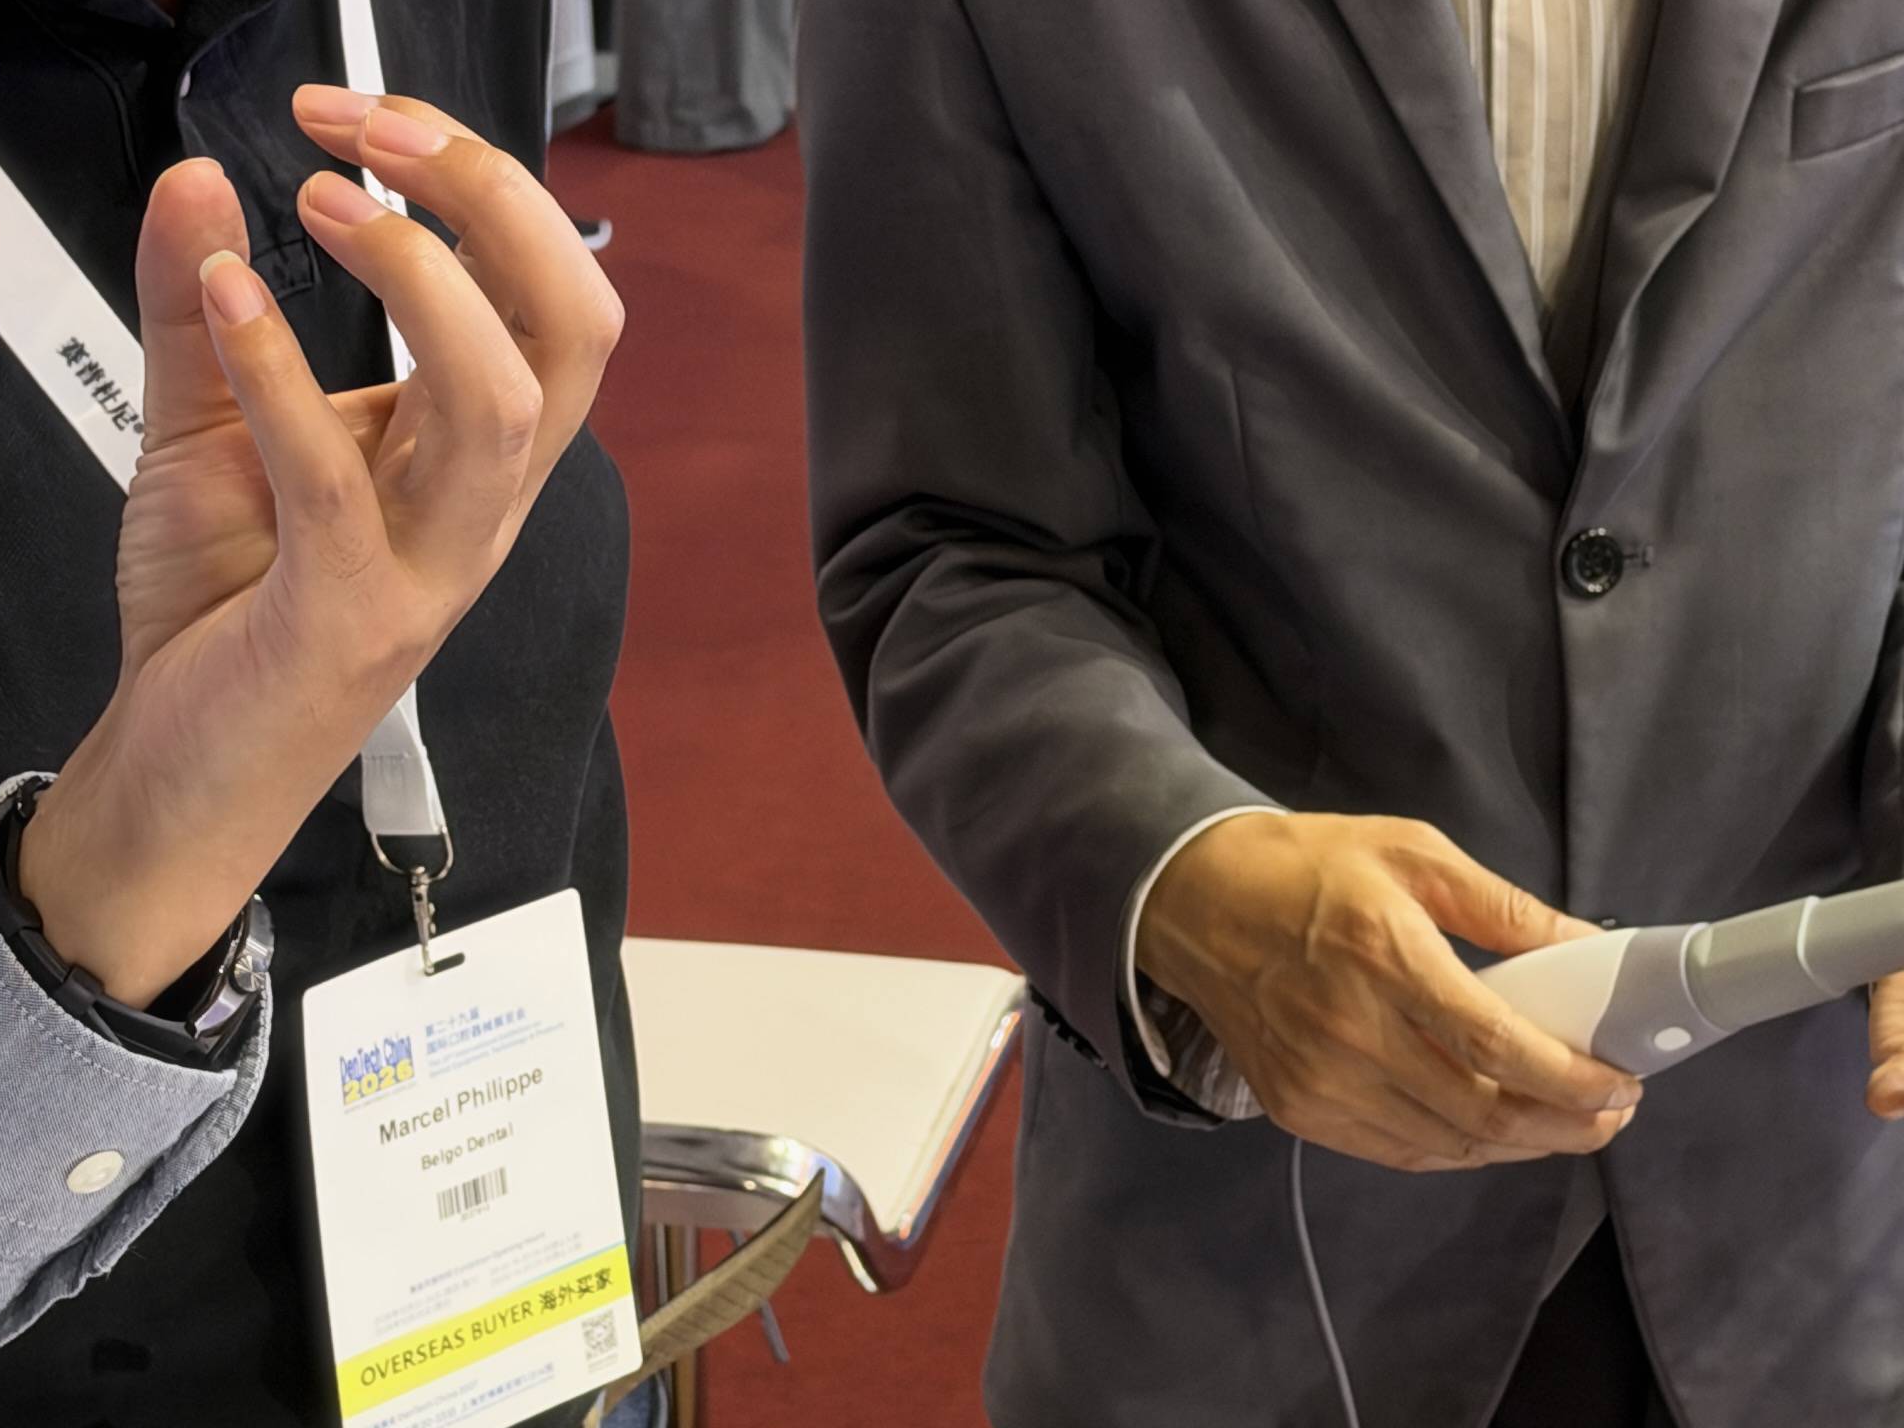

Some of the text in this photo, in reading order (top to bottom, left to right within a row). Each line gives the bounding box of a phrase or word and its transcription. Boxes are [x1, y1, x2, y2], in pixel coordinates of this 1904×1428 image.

[343, 1059, 414, 1105] 2026
[379, 1097, 451, 1145] Marcel
[456, 1068, 544, 1115] Philippe
[421, 1122, 514, 1171] Belgo Dental
[360, 1328, 466, 1388] OVERSEAS
[471, 1300, 534, 1342] BUYER
[538, 1268, 613, 1315] 海外买家
